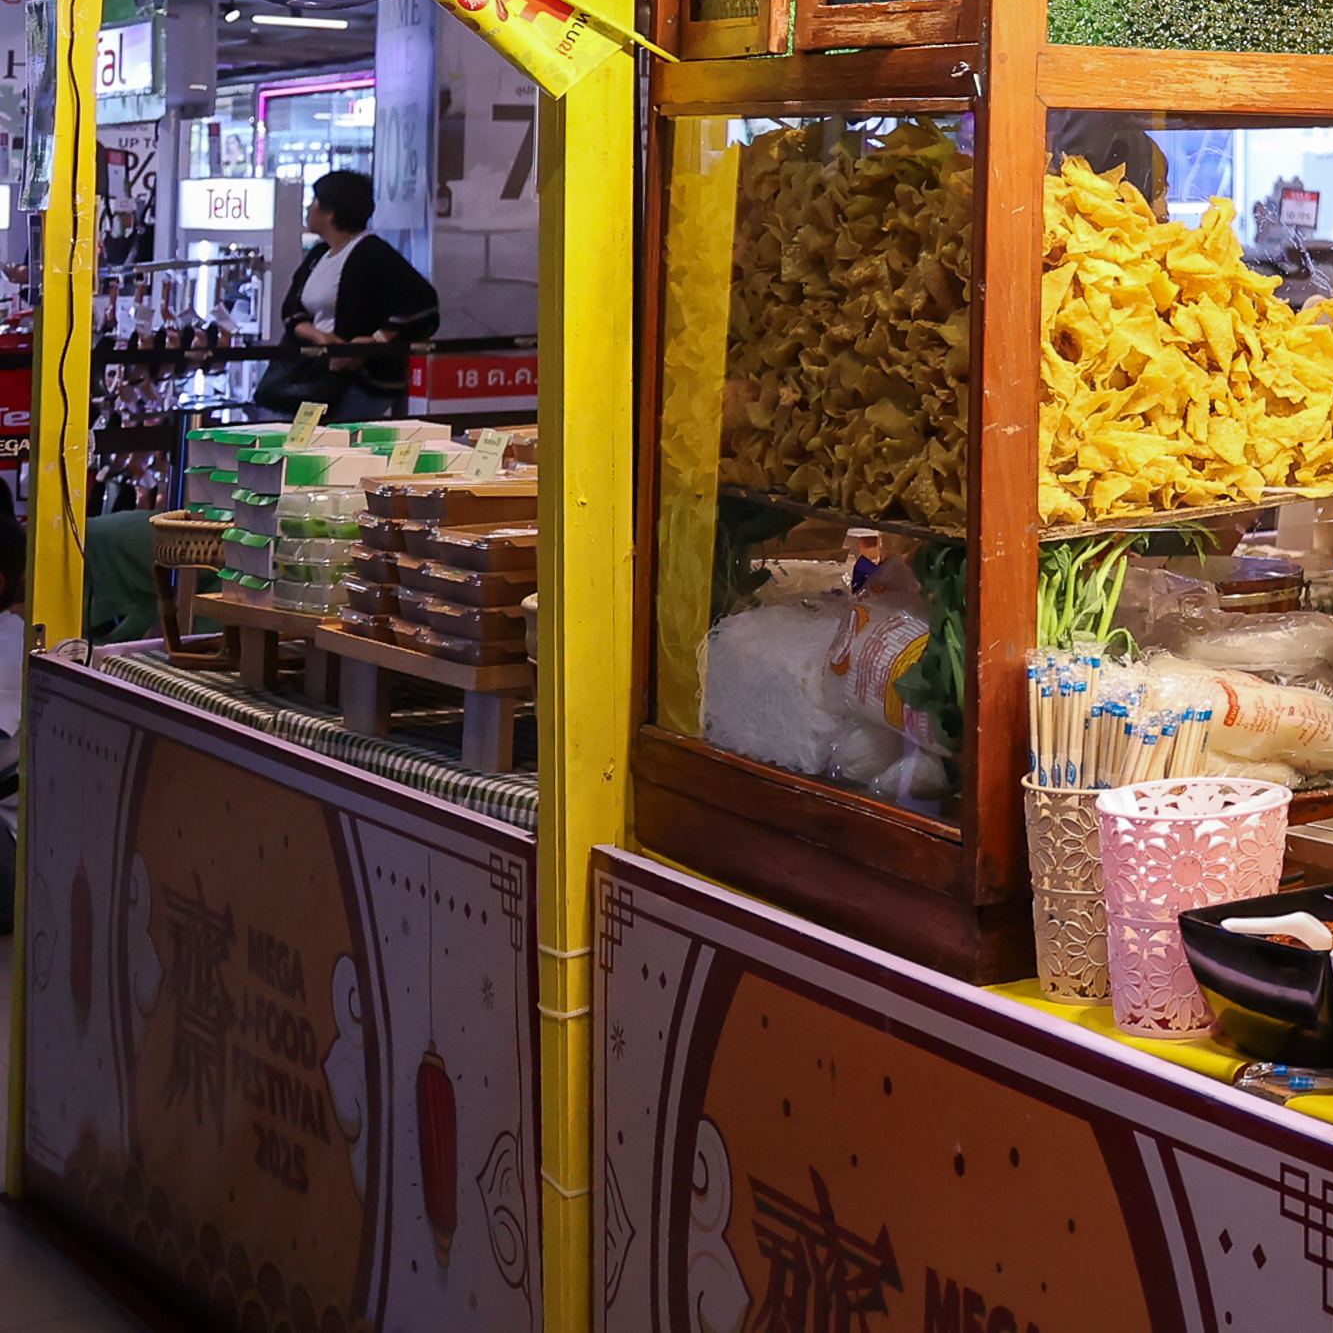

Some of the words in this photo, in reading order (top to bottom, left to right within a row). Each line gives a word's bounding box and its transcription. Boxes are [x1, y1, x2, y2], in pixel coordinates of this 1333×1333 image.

[206, 188, 249, 219] Tefal
[456, 369, 478, 388] 18
[248, 925, 307, 1004] MEGA
[232, 1042, 331, 1146] FESTIVAL
[253, 1121, 308, 1195] 2025
